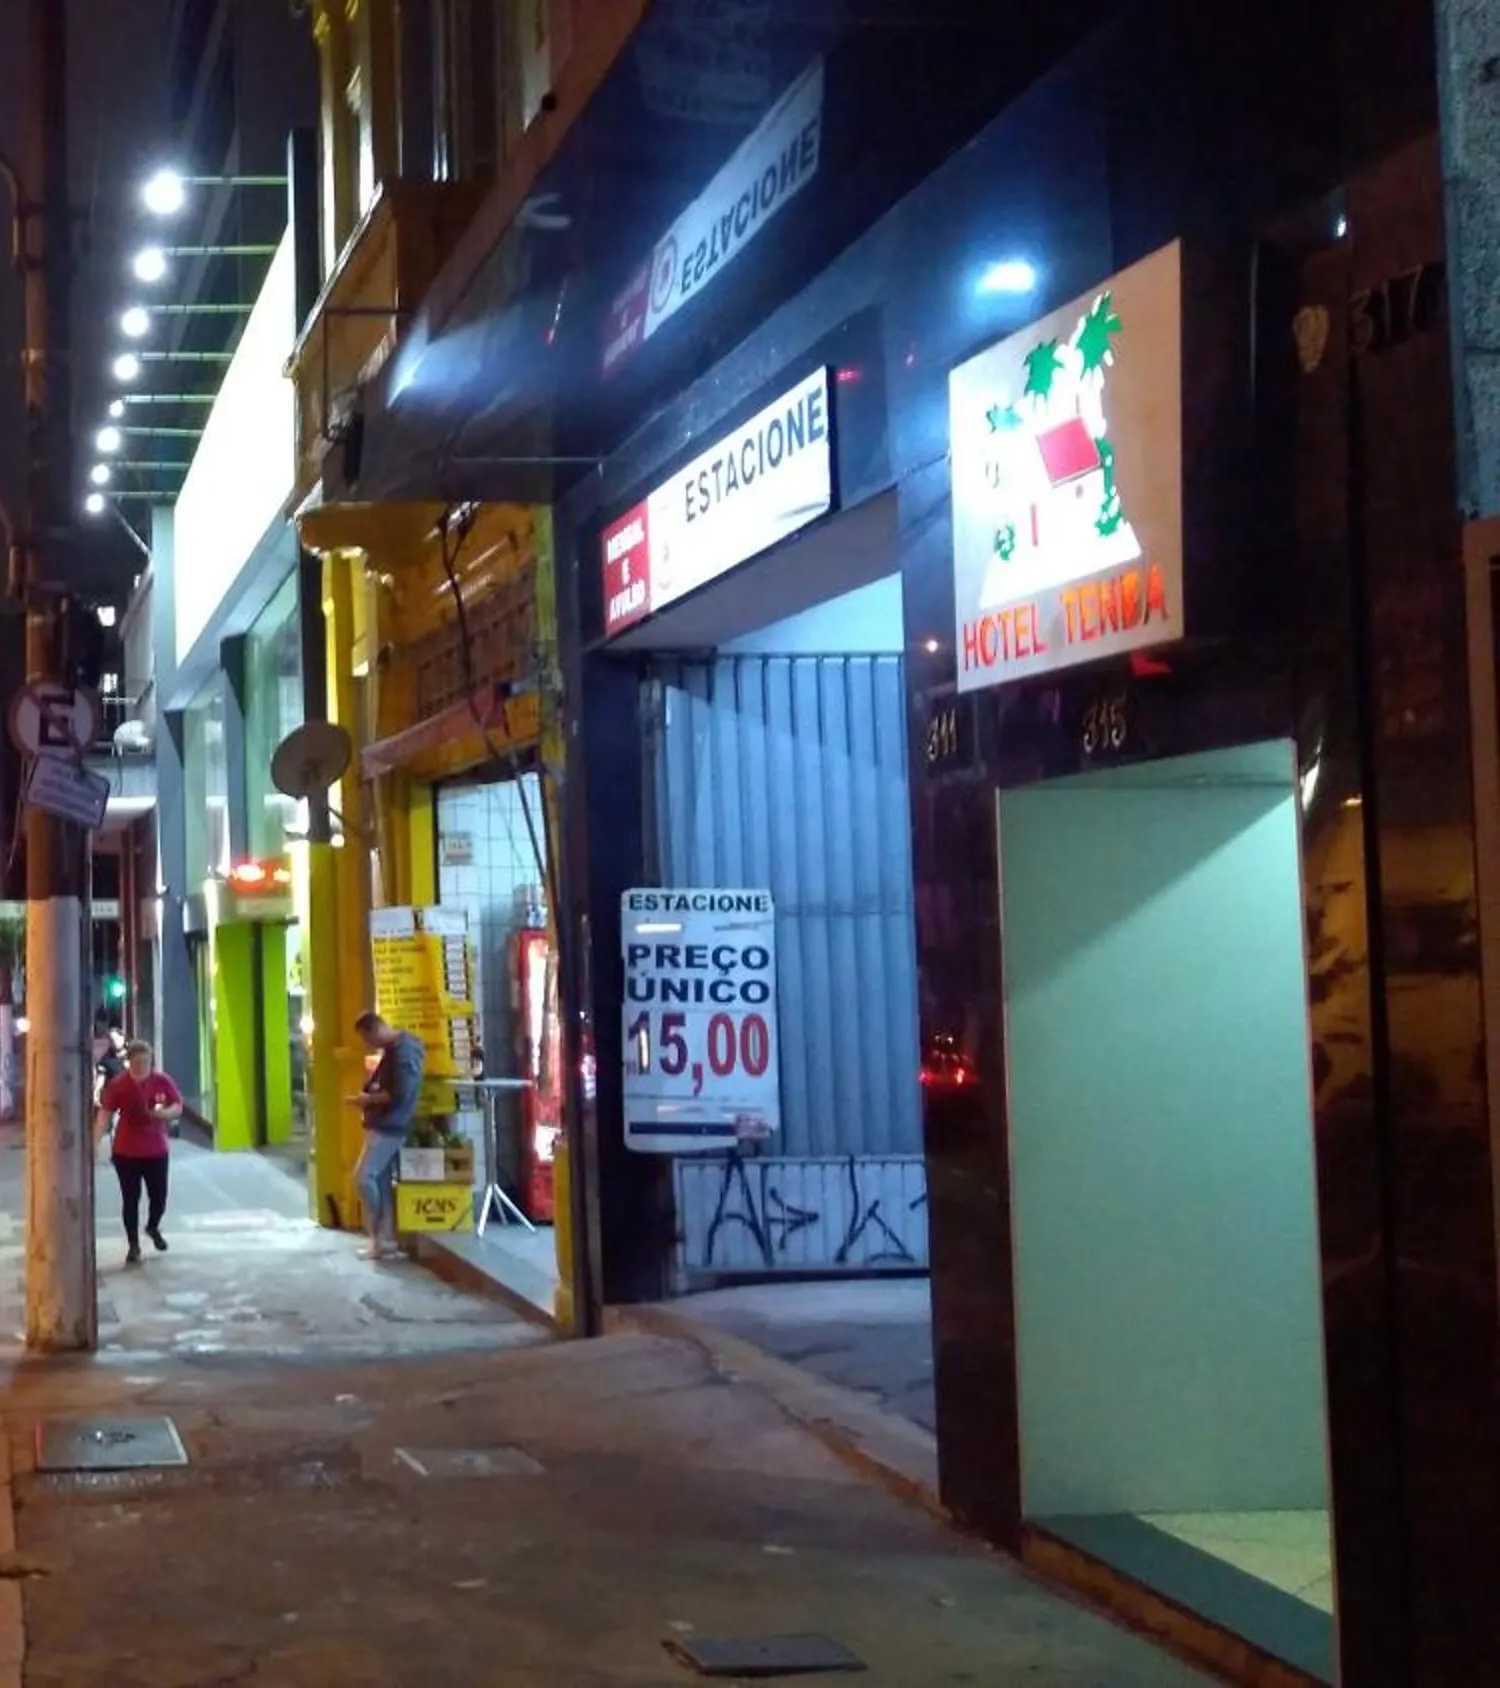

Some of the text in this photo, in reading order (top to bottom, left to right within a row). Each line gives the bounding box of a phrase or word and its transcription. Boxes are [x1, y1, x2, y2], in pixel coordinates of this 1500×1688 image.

[685, 384, 826, 523] ESTACIONE
[963, 562, 1169, 672] HOTEL TENDA
[1083, 698, 1127, 753] 315
[628, 893, 769, 912] ESTACIONE
[627, 944, 771, 976] PREÇO
[627, 970, 771, 1004] ÚNICO
[628, 1010, 769, 1097] 15,00
